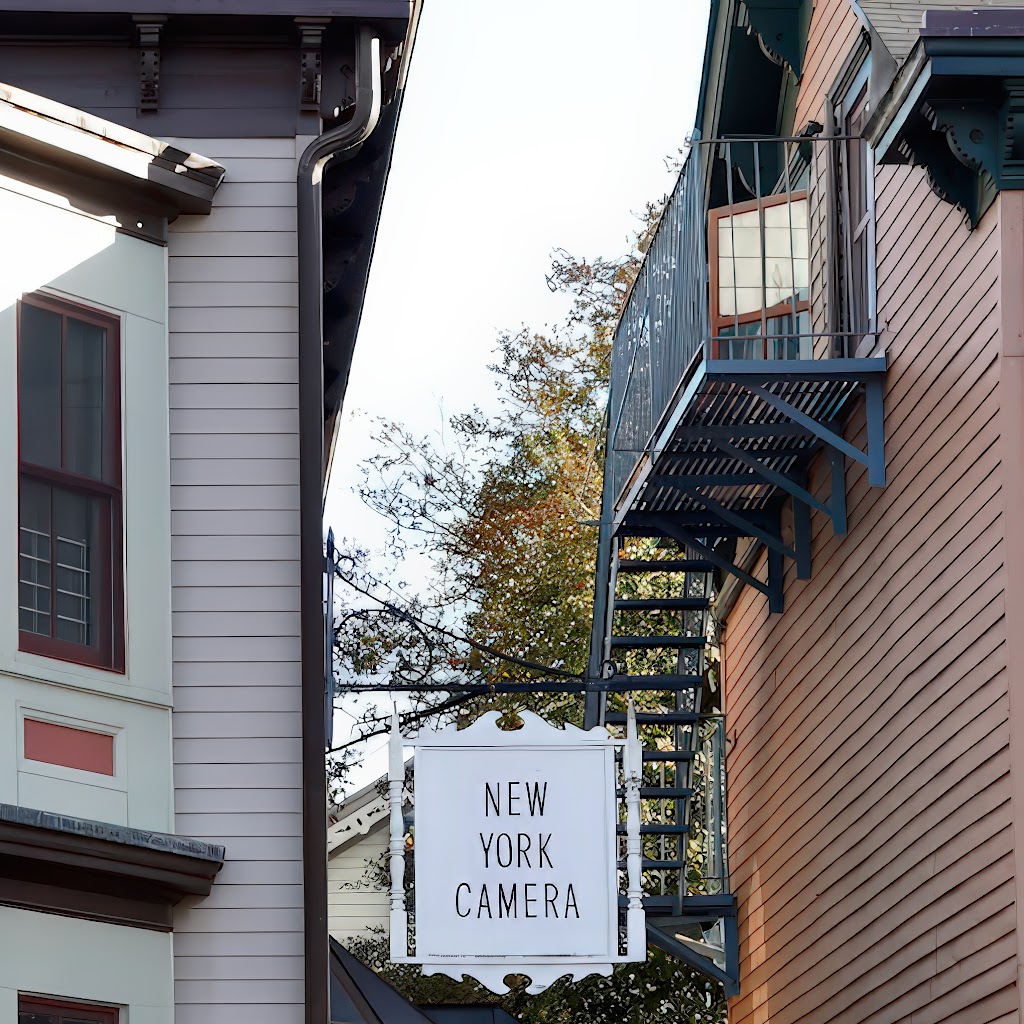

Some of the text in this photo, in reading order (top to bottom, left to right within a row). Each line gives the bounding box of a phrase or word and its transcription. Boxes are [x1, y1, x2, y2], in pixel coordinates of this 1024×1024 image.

[485, 781, 548, 817] NEW
[479, 832, 554, 869] YORK
[455, 882, 580, 919] CAMERA
